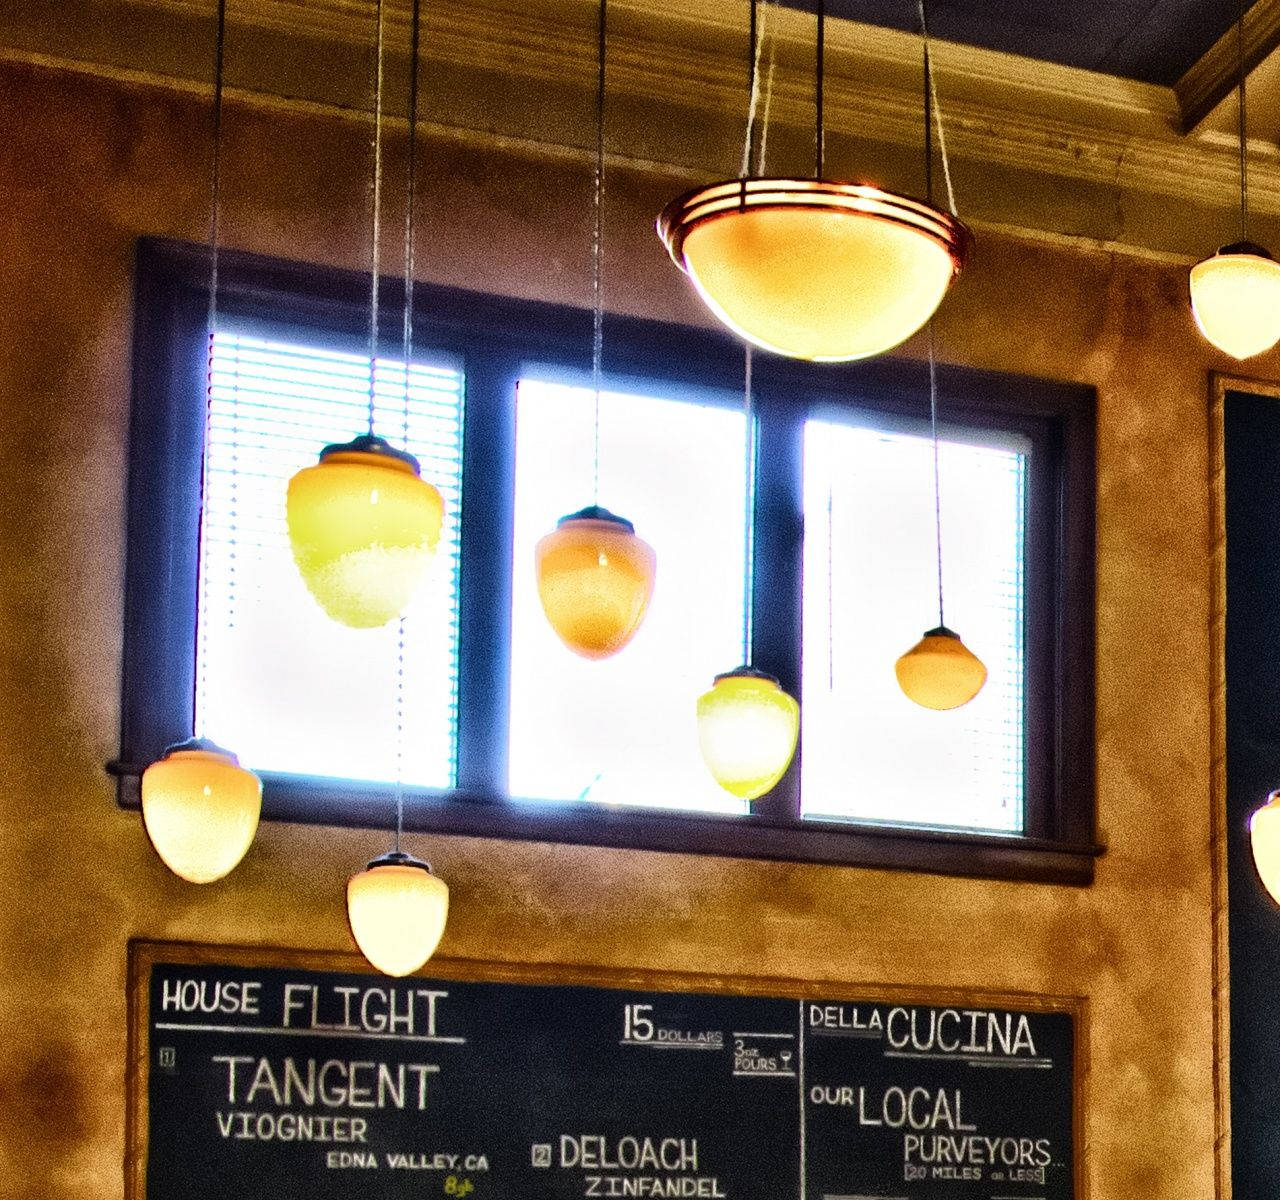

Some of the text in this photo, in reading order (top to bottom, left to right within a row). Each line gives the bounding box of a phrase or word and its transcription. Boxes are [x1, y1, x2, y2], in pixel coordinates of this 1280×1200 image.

[162, 980, 449, 1036] HOUSE FLIGHT
[624, 1004, 723, 1043] 15 DOLLARS
[809, 1005, 1037, 1056] DELLA CUCINA
[212, 1055, 441, 1110] TANGENT
[734, 1057, 777, 1071] POURS
[216, 1111, 368, 1142] VIOGNIER
[810, 1086, 977, 1131] OUR LOCAL
[327, 1151, 378, 1169] EDNA
[560, 1134, 699, 1172] DELOACH
[585, 1175, 726, 1199] ZINFANDEL
[932, 1166, 982, 1180] MILES
